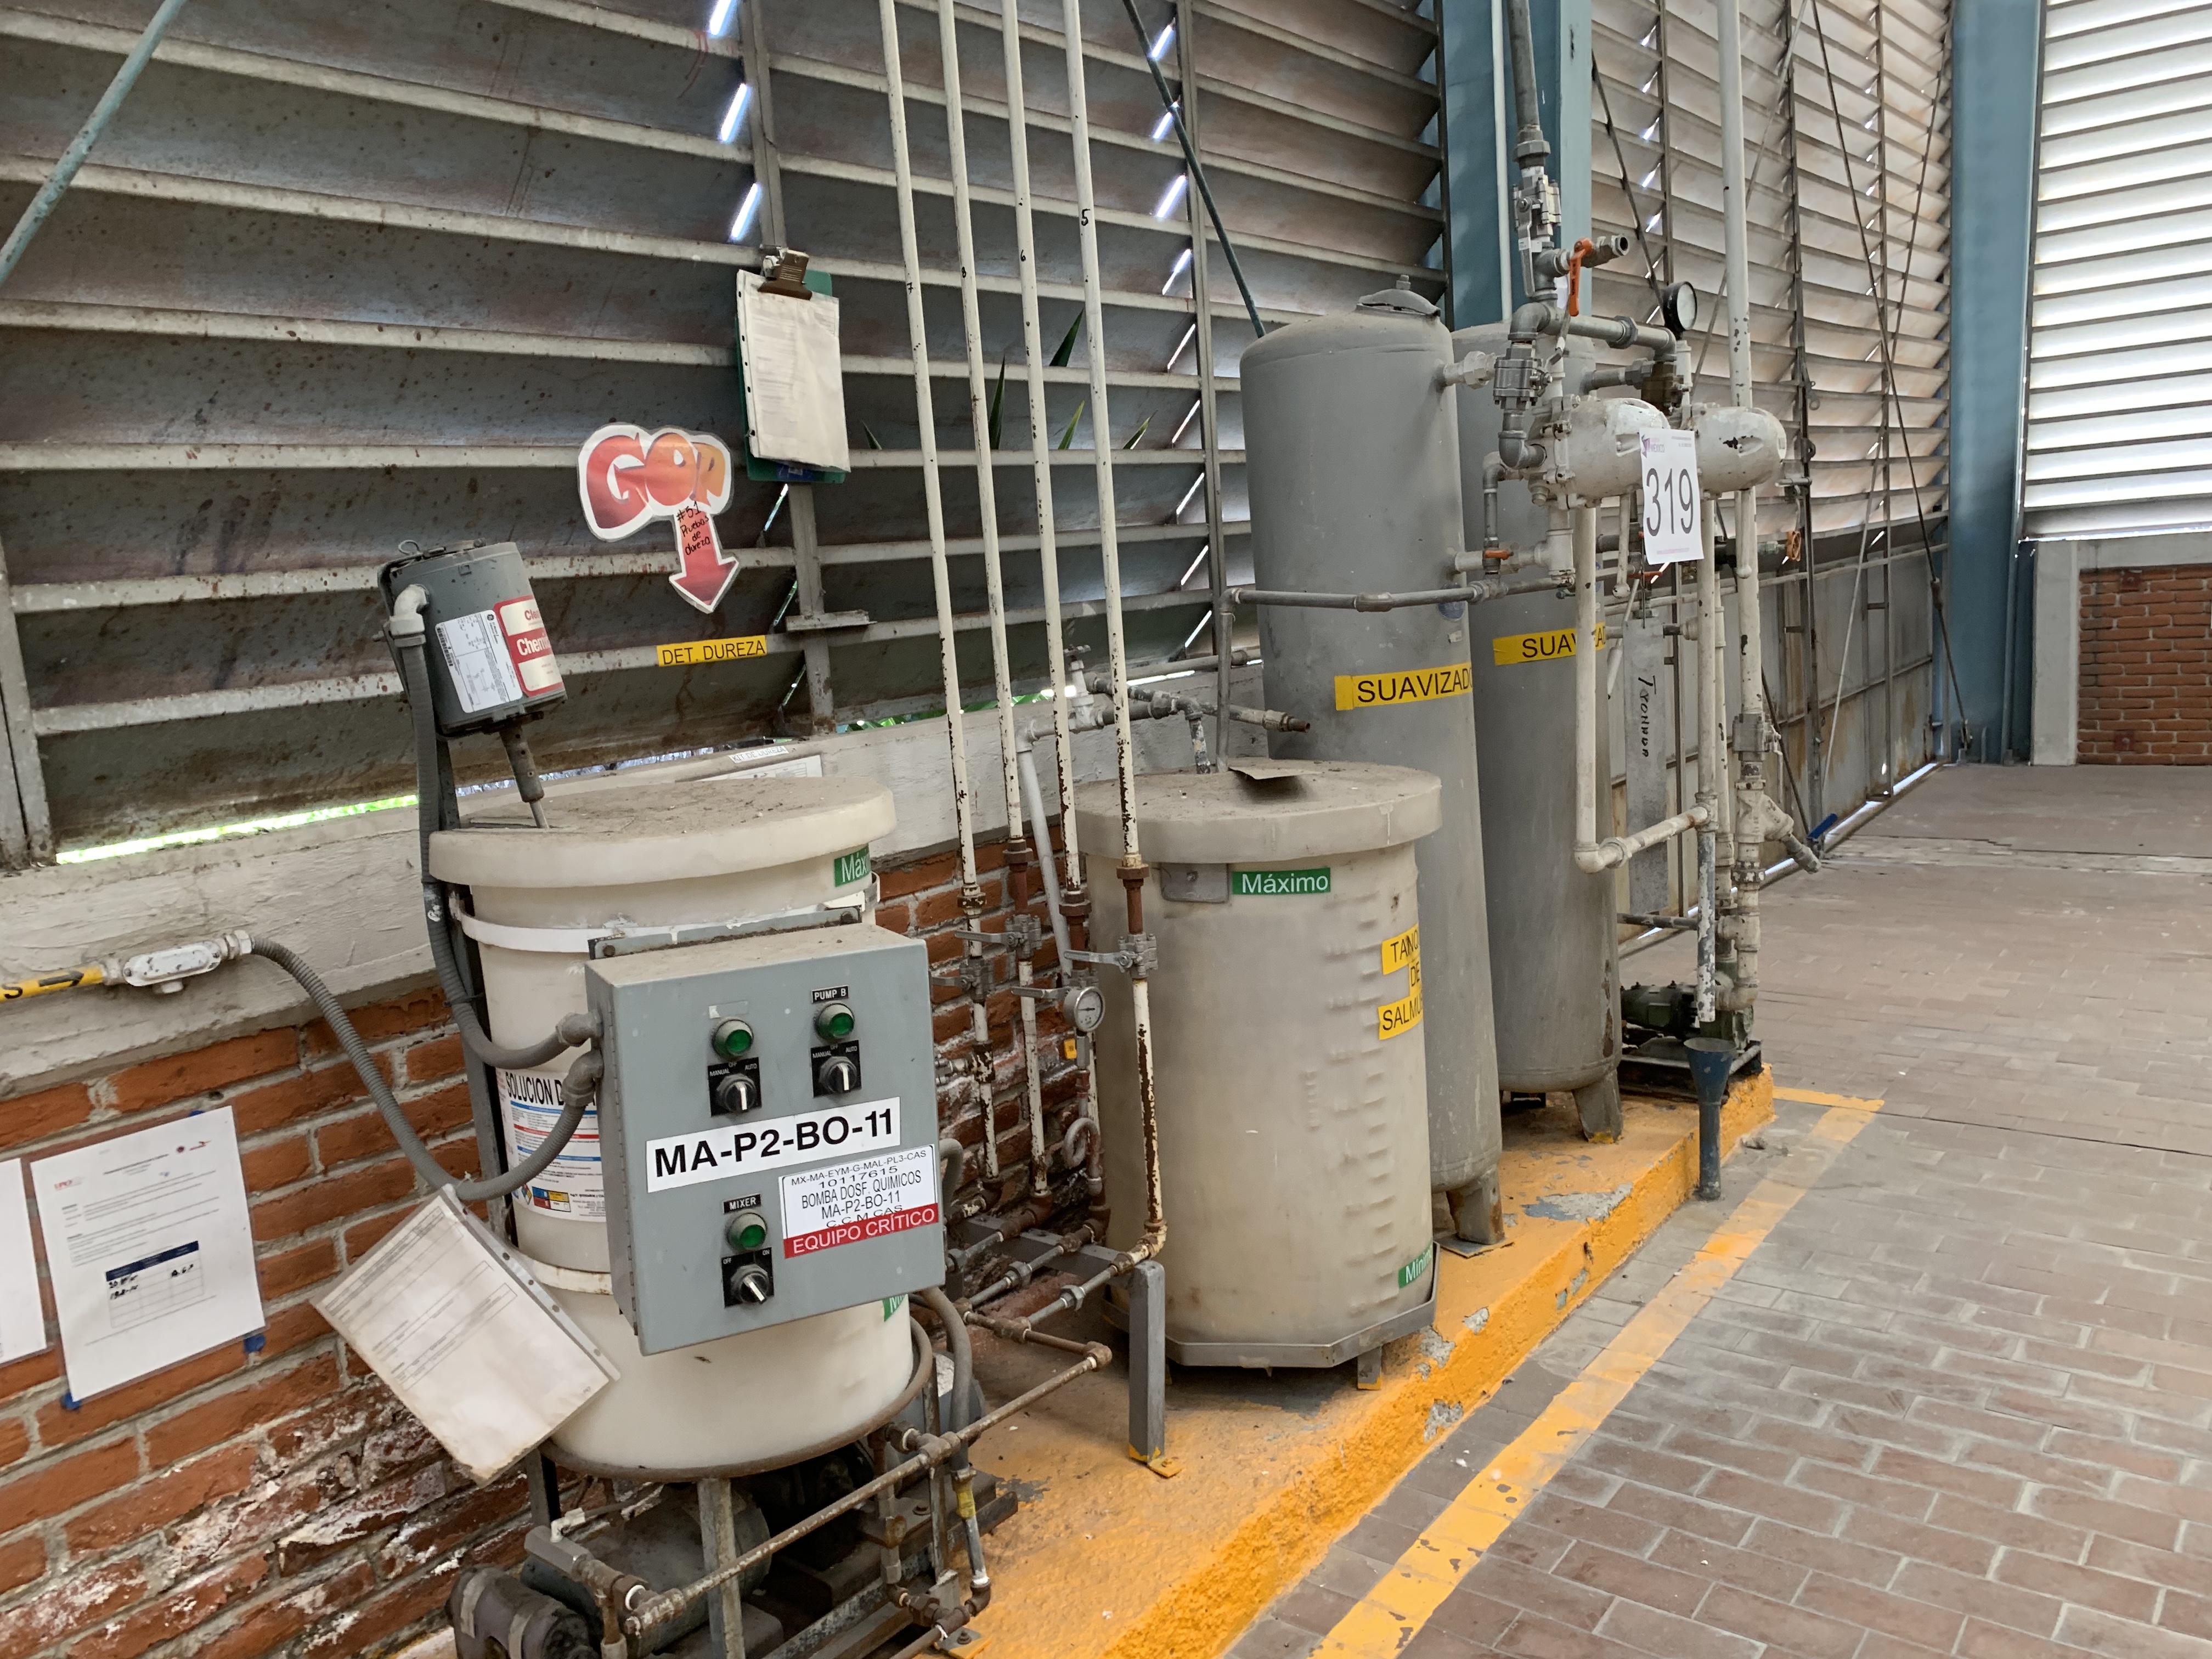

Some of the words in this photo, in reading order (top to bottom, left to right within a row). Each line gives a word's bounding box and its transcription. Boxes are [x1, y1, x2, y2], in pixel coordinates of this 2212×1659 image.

[1081, 208, 1091, 226] 5
[1020, 249, 1026, 262] 6
[961, 266, 967, 278] 8
[906, 282, 913, 295] 7
[1646, 467, 1694, 537] 319
[680, 516, 710, 537] Pruebas
[692, 530, 701, 541] de
[685, 536, 711, 556] dureza
[662, 647, 698, 665] DET.
[703, 640, 765, 661] DUREZA
[1242, 873, 1329, 894] Máximo
[1410, 961, 1420, 988] DE
[814, 989, 837, 1001] PUMP
[840, 988, 847, 997] B
[812, 1050, 832, 1059] MANUAL
[709, 1068, 730, 1077] MANUAL
[505, 1071, 554, 1105] SOLUCION
[654, 1108, 892, 1177] MA-P2-BO-11
[791, 1150, 926, 1186] MX-MA-EYM-G-MAL-PL3-CAS
[819, 1165, 898, 1189] 10117615
[802, 1188, 838, 1209] BOMBA
[840, 1181, 871, 1200] DOSF.
[873, 1170, 922, 1192] QUIMICOS
[729, 1197, 757, 1210] MIXER
[822, 1190, 900, 1220] MA-P2-BO-11
[793, 1226, 861, 1254] EQUIPO
[866, 1208, 935, 1236] CRÍTICO
